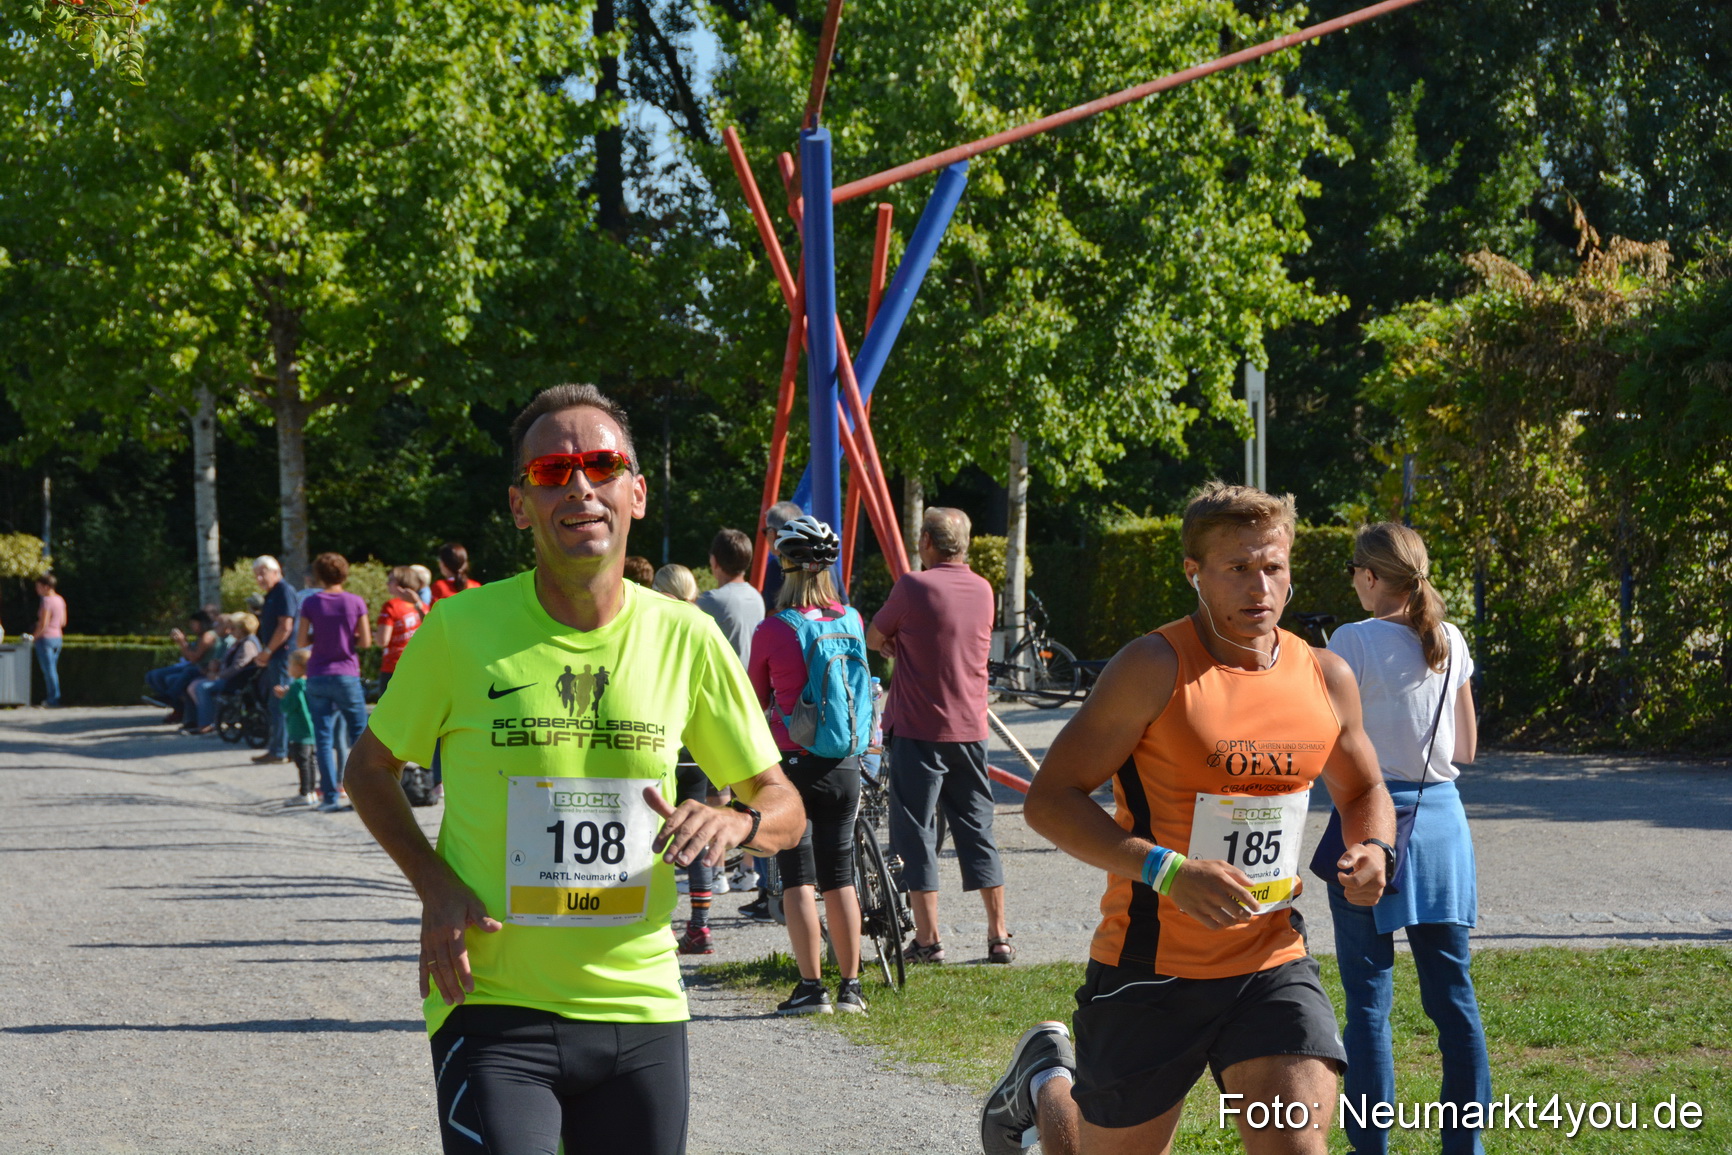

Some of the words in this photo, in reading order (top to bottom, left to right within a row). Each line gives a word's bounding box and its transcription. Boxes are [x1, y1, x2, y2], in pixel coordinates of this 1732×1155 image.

[492, 718, 517, 729] SC
[1216, 740, 1257, 753] OPTIK
[1297, 743, 1326, 751] SCHMUCK
[1225, 752, 1301, 776] OEXL
[1258, 783, 1294, 792] VISION
[554, 791, 621, 808] BOCK
[1232, 807, 1283, 820] BOCK
[546, 820, 626, 865] 198
[1223, 829, 1283, 867] 185
[515, 854, 521, 863] A
[539, 871, 572, 881] PARTL
[574, 871, 616, 881] Neumarkt
[1244, 870, 1272, 880] eumarkt
[1250, 885, 1270, 901] ard
[567, 892, 600, 911] Udo
